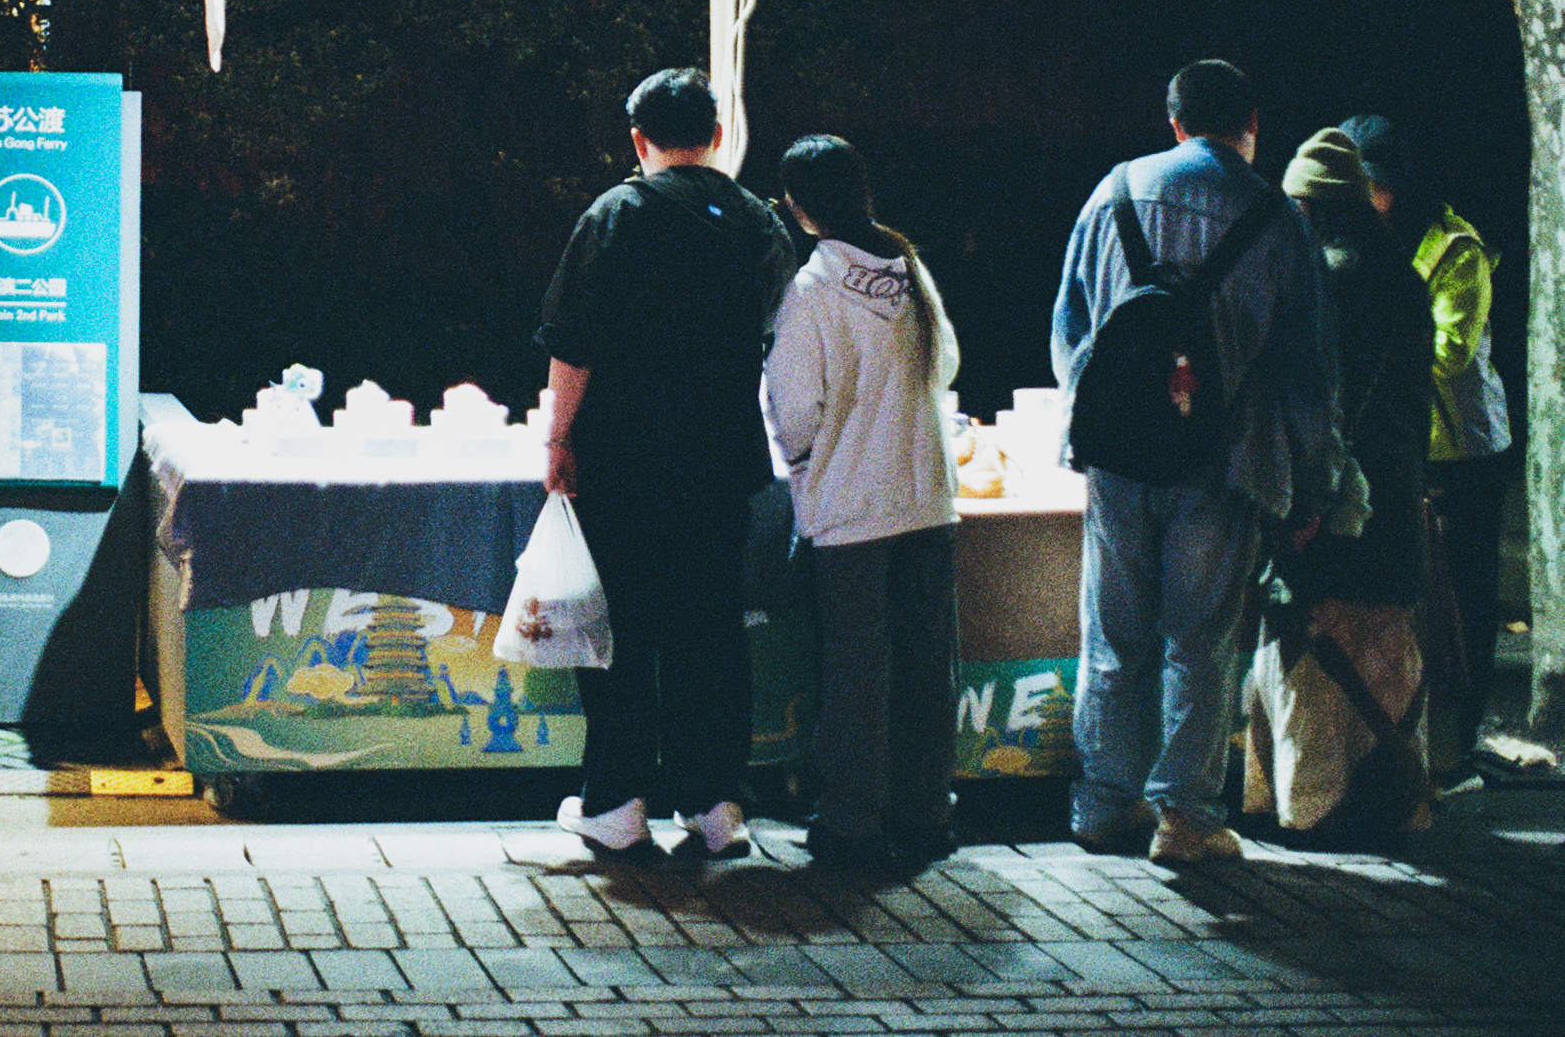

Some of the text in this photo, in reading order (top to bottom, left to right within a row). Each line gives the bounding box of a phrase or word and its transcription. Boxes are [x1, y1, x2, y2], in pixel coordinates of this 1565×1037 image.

[4, 136, 35, 151] Gong
[37, 137, 67, 151] Ferry
[16, 309, 37, 321] 2nd
[39, 309, 66, 321] Park
